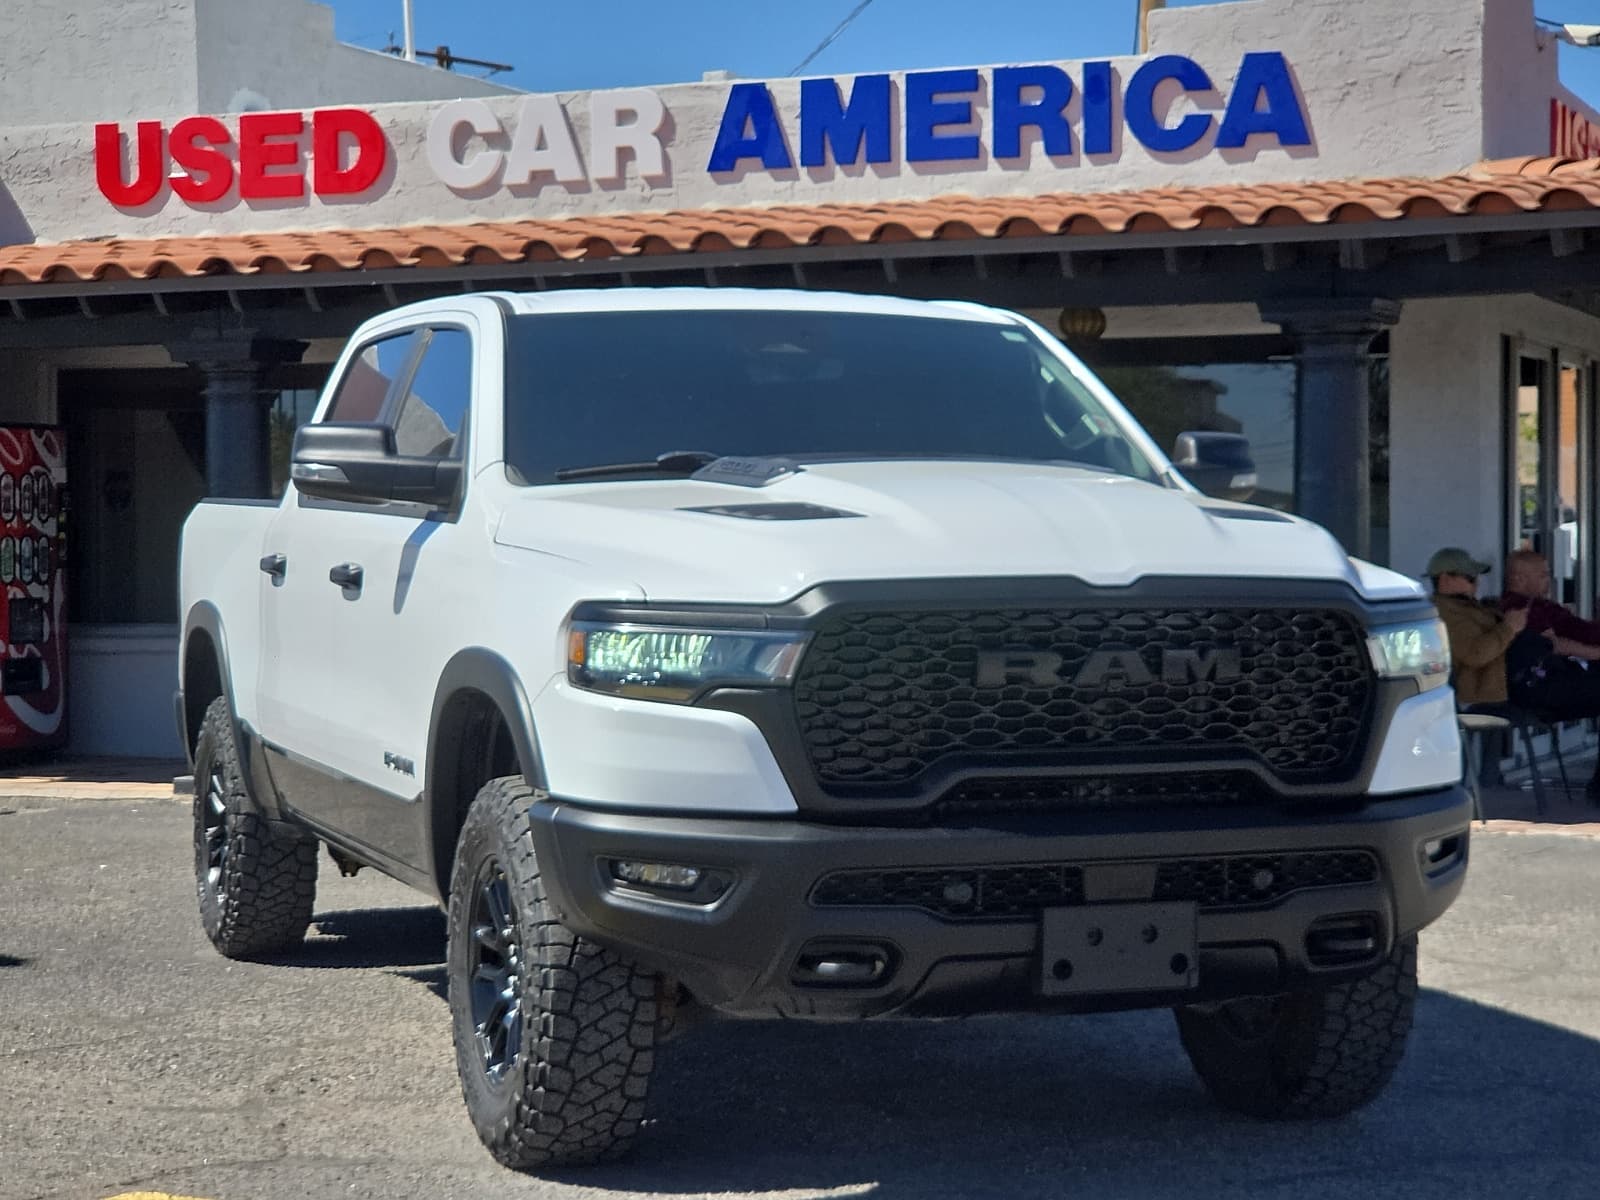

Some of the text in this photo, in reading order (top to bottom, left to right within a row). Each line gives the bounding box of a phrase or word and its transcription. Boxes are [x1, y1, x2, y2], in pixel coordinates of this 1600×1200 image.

[95, 51, 1311, 207] USED CAR AMERICA
[976, 647, 1242, 688] RAM
